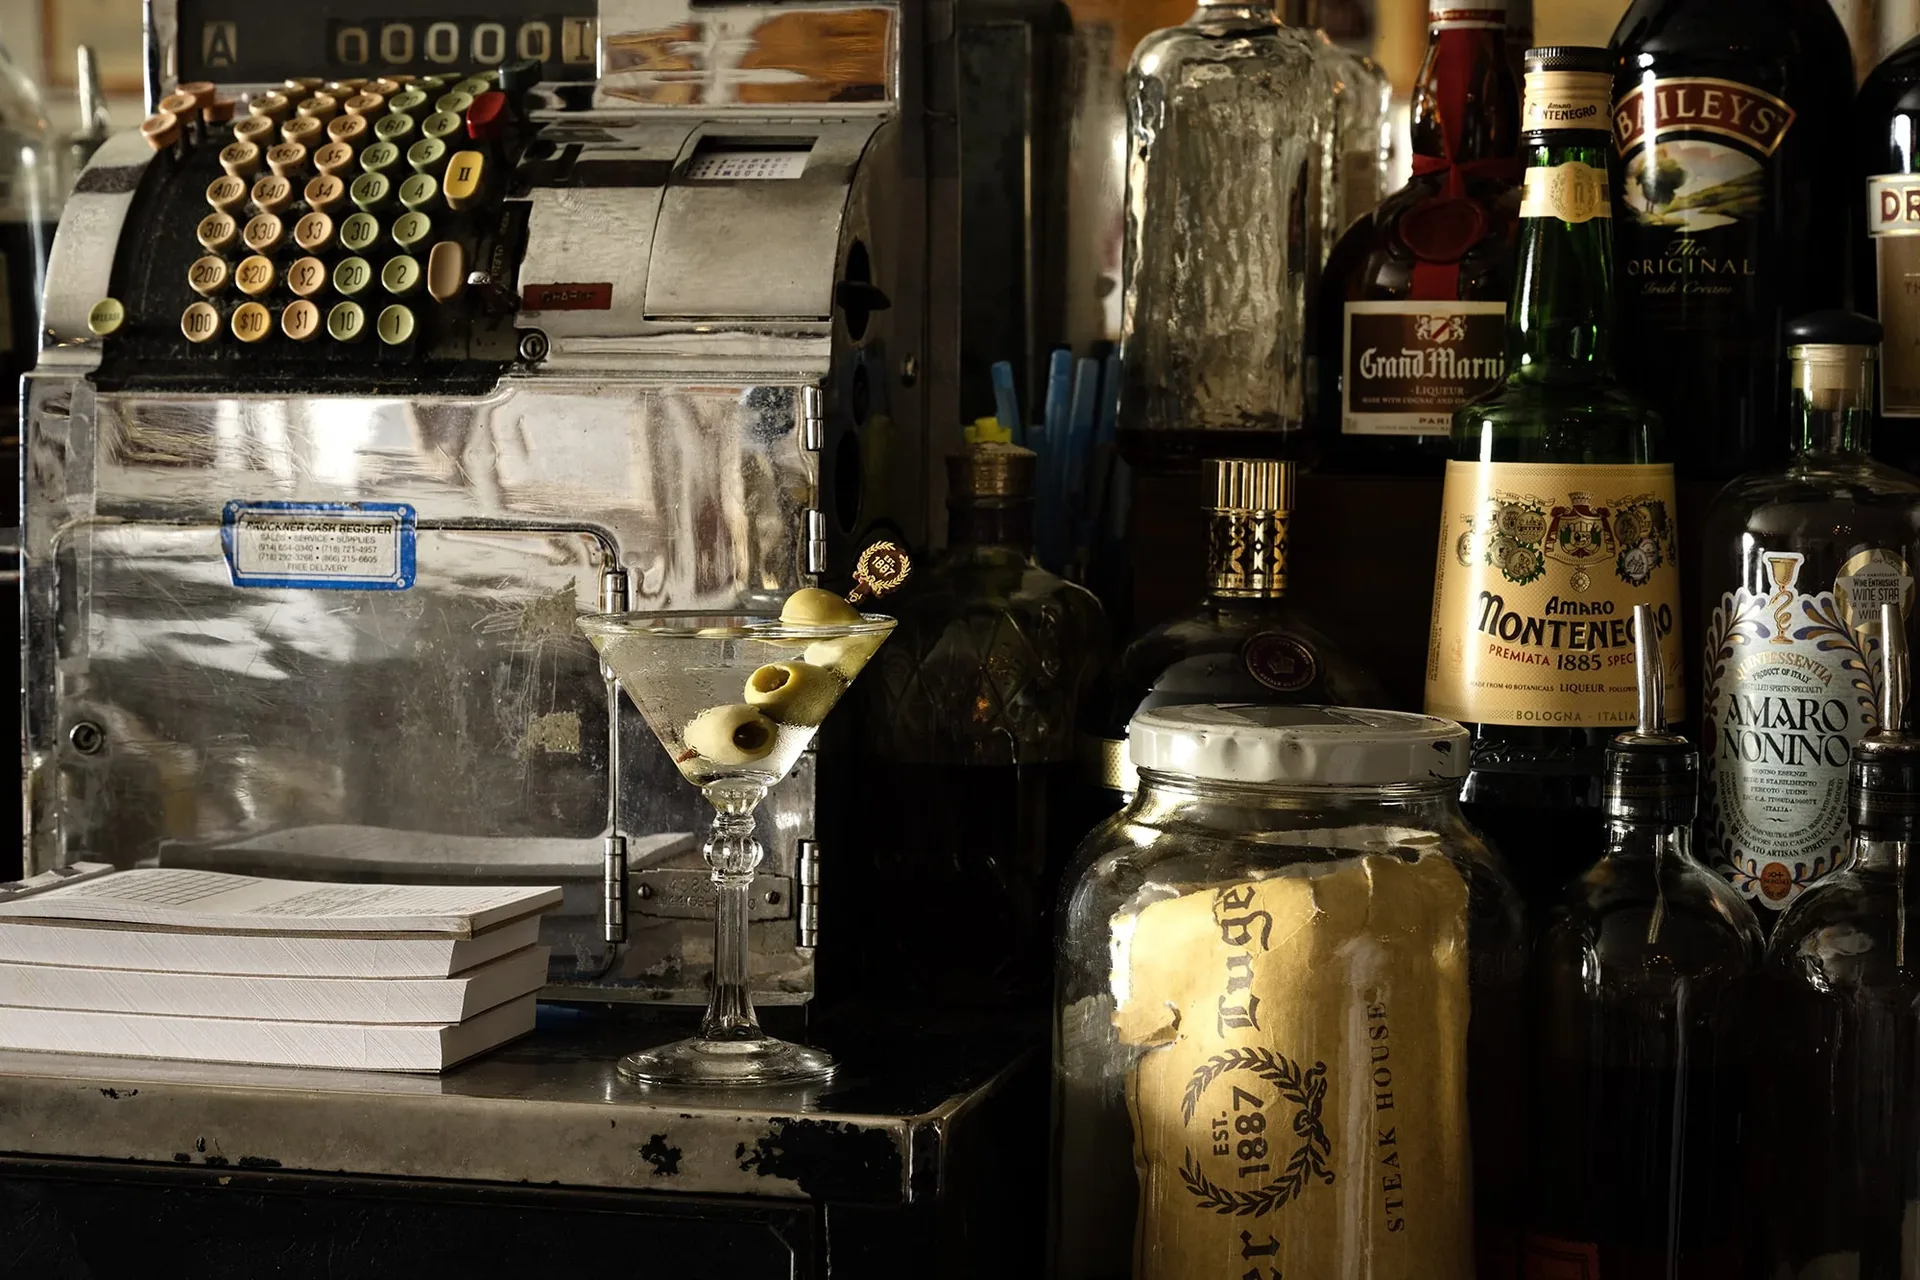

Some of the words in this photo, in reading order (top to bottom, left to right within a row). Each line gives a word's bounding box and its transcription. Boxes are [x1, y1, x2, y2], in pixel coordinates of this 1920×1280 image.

[384, 121, 405, 131] 60
[438, 118, 448, 131] 6
[326, 151, 342, 163] $5
[371, 150, 391, 163] 50
[422, 146, 433, 158] 5
[457, 167, 471, 181] II
[214, 183, 239, 198] 400
[258, 183, 285, 198] $40
[316, 183, 333, 198] $4
[361, 181, 381, 197] 40
[415, 183, 425, 198] 4
[204, 222, 230, 239] 300
[251, 222, 276, 240] $30
[306, 221, 322, 240] $3
[351, 222, 370, 241] 30
[407, 220, 417, 238] 3
[194, 265, 222, 283] 200
[242, 265, 267, 284] $20
[300, 266, 315, 286] $2
[343, 266, 363, 286] 20
[397, 265, 407, 284] 2
[1627, 258, 1756, 276] ORIGINAL
[190, 313, 212, 333] 100
[240, 313, 263, 333] $10
[296, 310, 307, 330] $1
[341, 311, 354, 331] 10
[395, 315, 400, 335] 1
[1360, 347, 1426, 380] Grand
[339, 523, 392, 534] REGISTER
[336, 535, 376, 545] SUPPLIES
[871, 556, 896, 578] 1887
[1488, 643, 1551, 667] PREMIATA
[1557, 653, 1603, 672] 1885
[1790, 669, 1812, 684] ITALY
[1513, 683, 1555, 692] BOTANICALS
[1559, 683, 1606, 695] LIQUEUR
[1791, 685, 1823, 694] SPECIALTY
[1516, 710, 1582, 722] BOLOGNA
[1597, 711, 1636, 722] ITALIA
[1724, 693, 1849, 734] AMARO
[1722, 728, 1850, 767] NONINO
[1737, 834, 1765, 855] TERLATO
[1766, 849, 1799, 858] ARTISAN
[1772, 840, 1788, 848] AND
[1789, 829, 1823, 847] CARAMEL
[1367, 1002, 1396, 1113] HOUSE
[1212, 1111, 1230, 1157] EST.
[1233, 1085, 1272, 1179] 1887
[1373, 1125, 1405, 1233] STEAK
